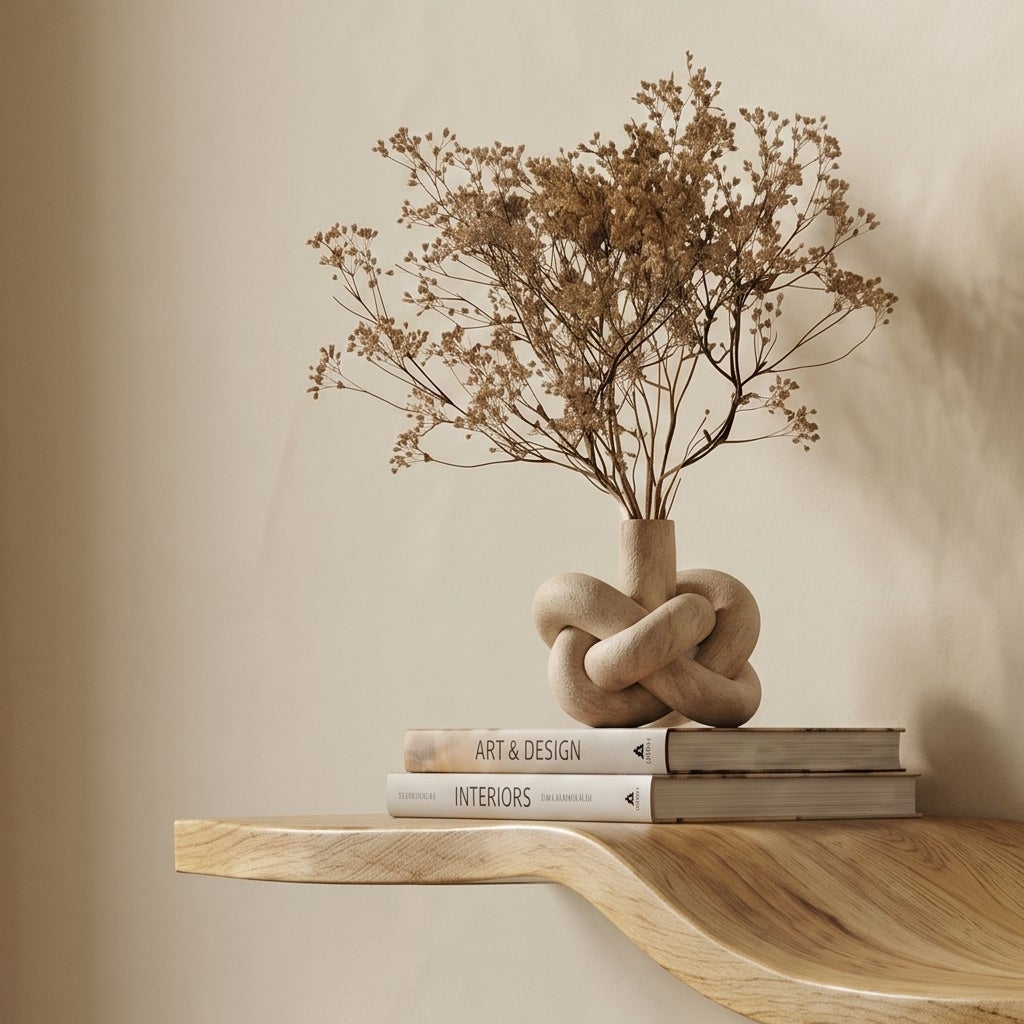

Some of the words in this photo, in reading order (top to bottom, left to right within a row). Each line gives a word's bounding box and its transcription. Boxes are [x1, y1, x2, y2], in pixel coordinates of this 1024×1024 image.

[475, 740, 504, 760] ART
[509, 740, 519, 760] &
[525, 740, 580, 760] DESIGN
[455, 786, 531, 808] INTERIORS
